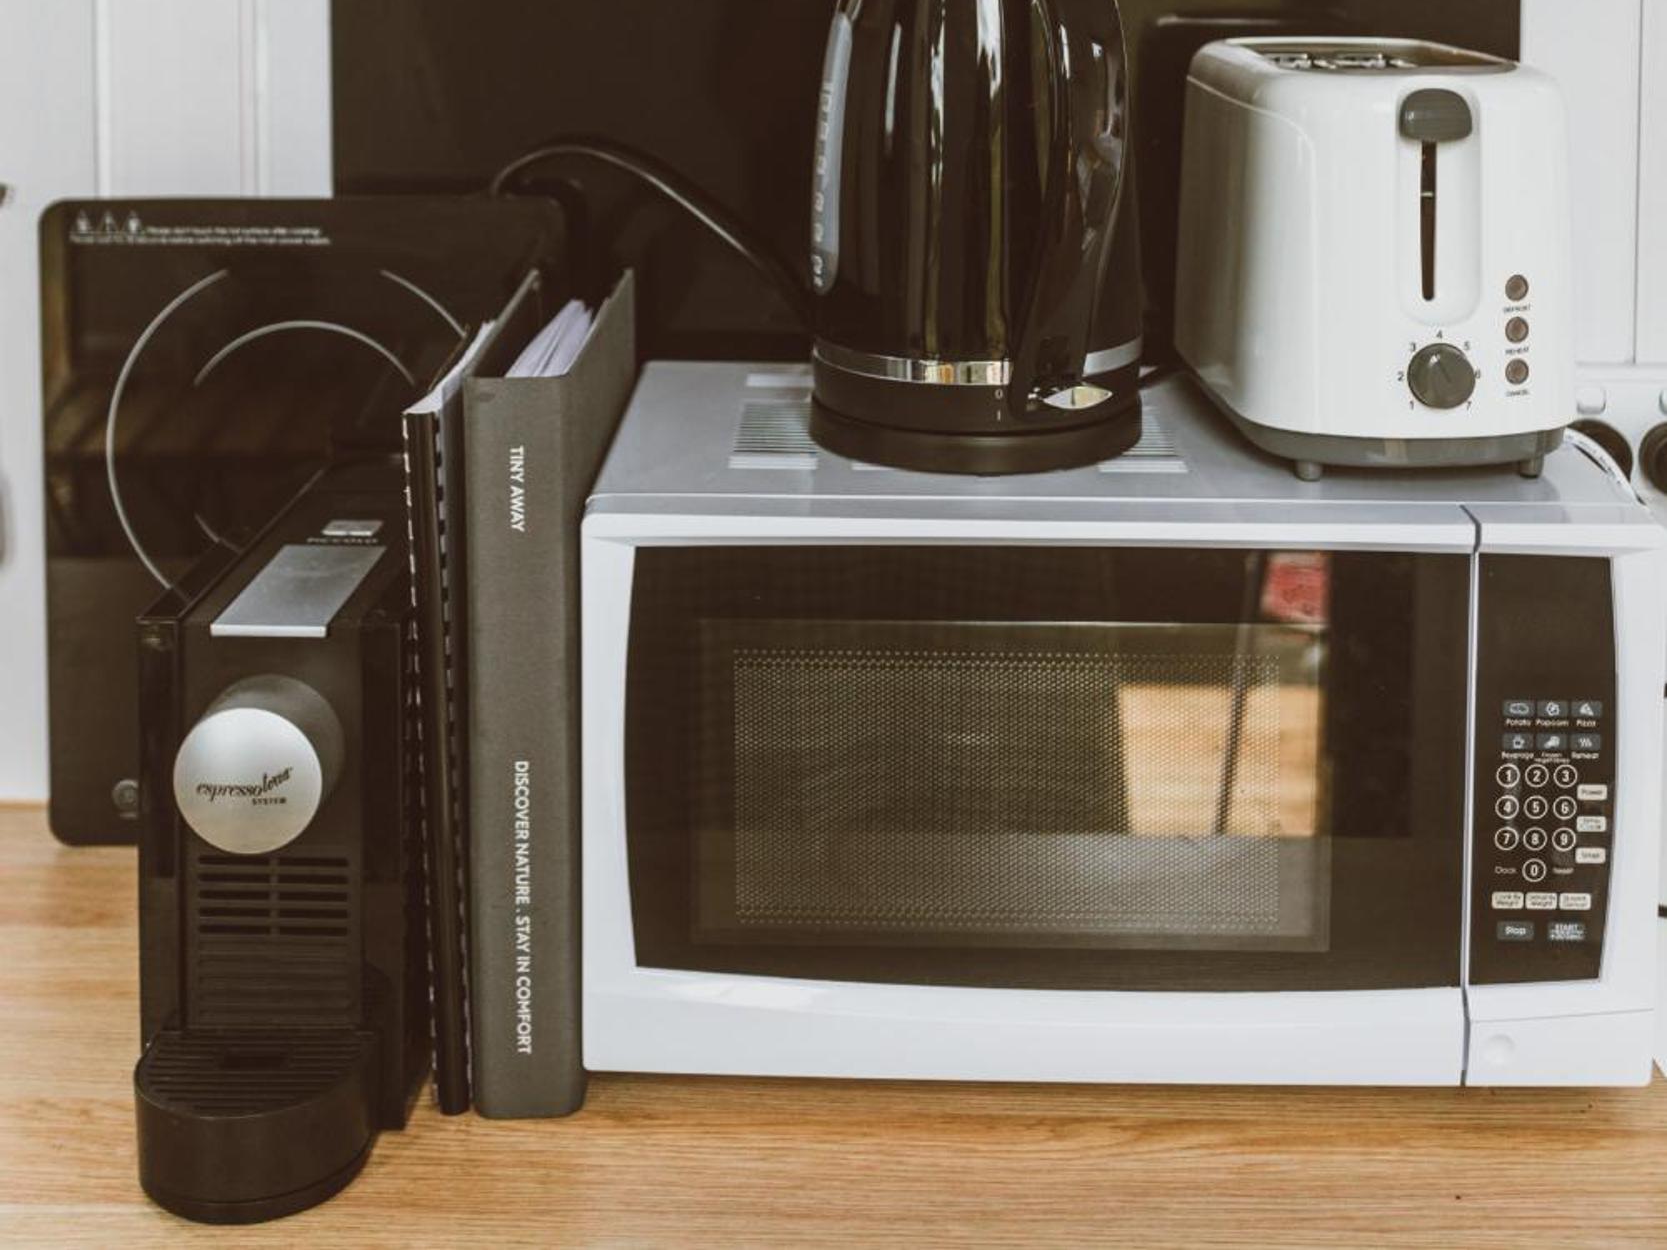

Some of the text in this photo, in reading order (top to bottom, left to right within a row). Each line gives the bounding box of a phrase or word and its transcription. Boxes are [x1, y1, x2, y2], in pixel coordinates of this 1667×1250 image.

[1436, 330, 1443, 339] 4
[1410, 342, 1416, 351] 3
[1464, 341, 1470, 350] 5
[1397, 371, 1405, 382] 2
[1466, 401, 1472, 410] 7
[509, 445, 526, 532] TINY AWAY
[1532, 770, 1541, 782] 2
[1561, 770, 1570, 782] 3
[514, 760, 530, 840] DISCOVER
[1503, 801, 1511, 813] 4
[1532, 801, 1540, 813] 5
[1561, 801, 1569, 814] 6
[1503, 833, 1510, 845] 7
[1531, 832, 1539, 845] 8
[1560, 833, 1568, 846] 9
[514, 842, 531, 905] NATURE
[1531, 864, 1538, 877] 0
[515, 915, 531, 952] STAY
[1505, 926, 1526, 936] Stop
[515, 956, 531, 972] IN
[516, 976, 532, 1054] COMFORT
